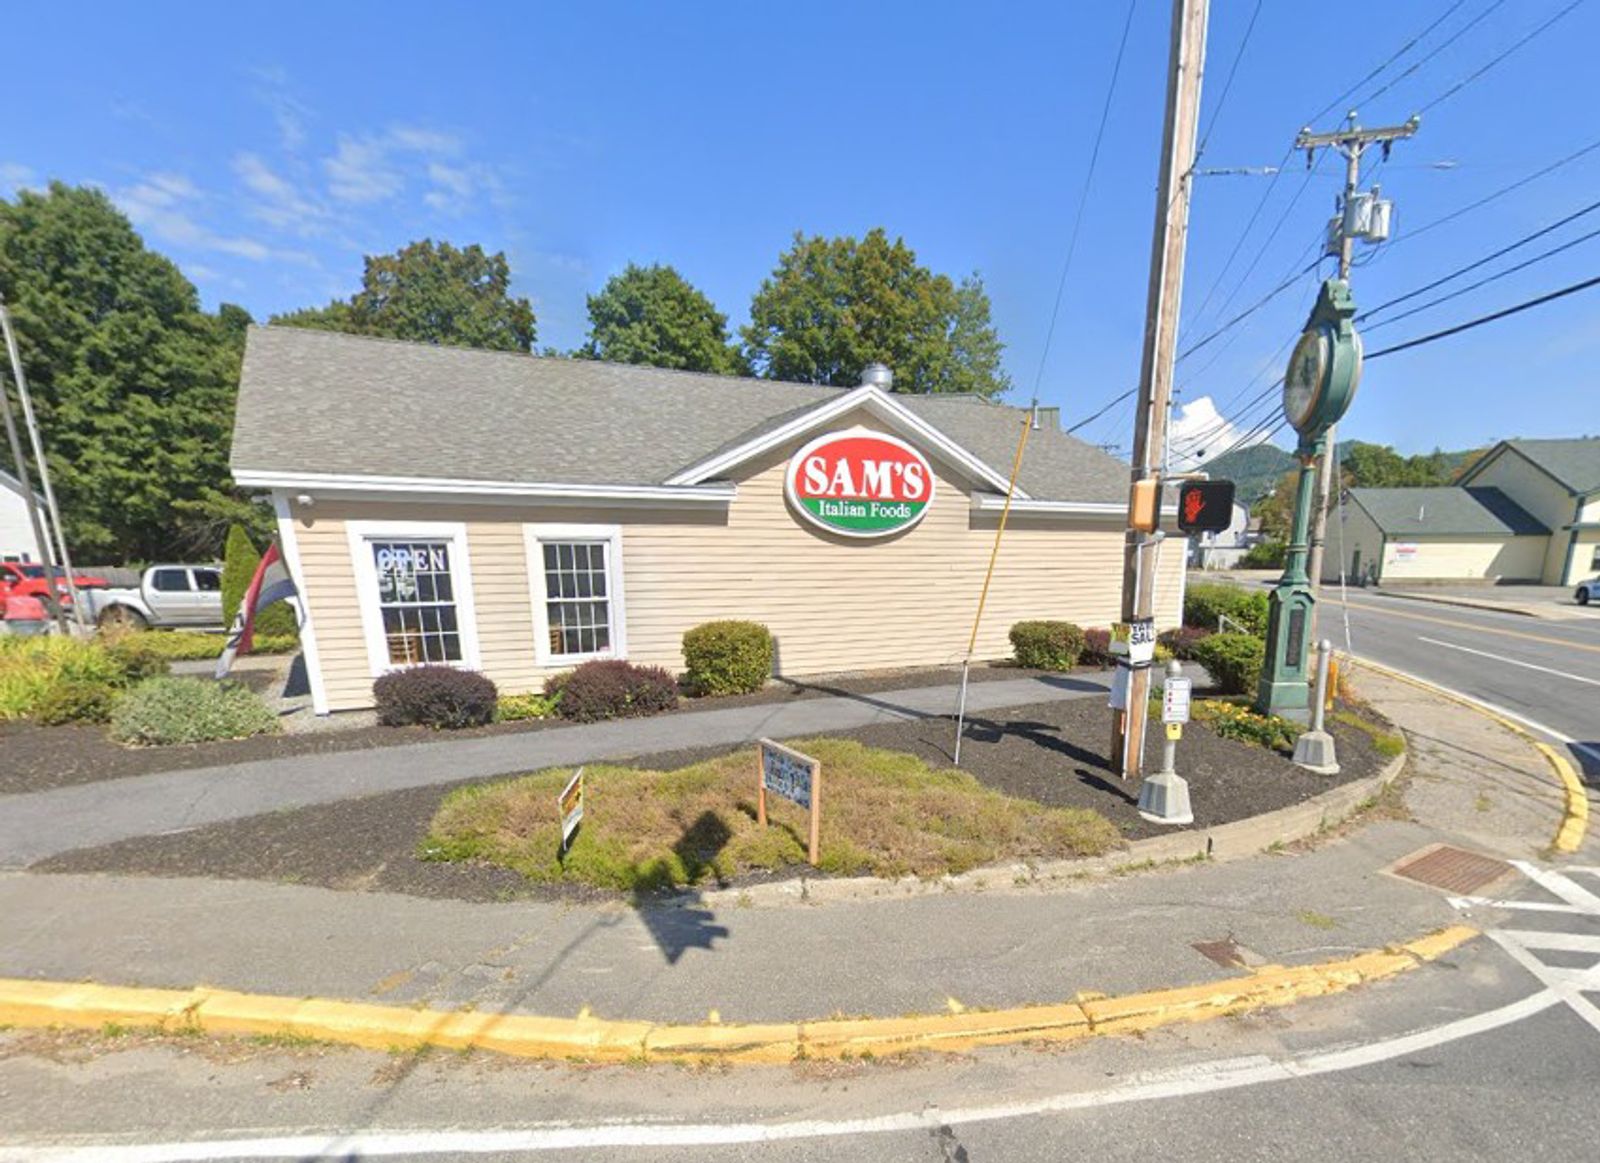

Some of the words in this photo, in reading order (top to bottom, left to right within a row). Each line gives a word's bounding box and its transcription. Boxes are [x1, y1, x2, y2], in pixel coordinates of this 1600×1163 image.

[804, 456, 924, 499] SAM'S
[819, 500, 866, 517] Italian
[870, 502, 912, 518] Foods
[377, 549, 445, 570] OPEN
